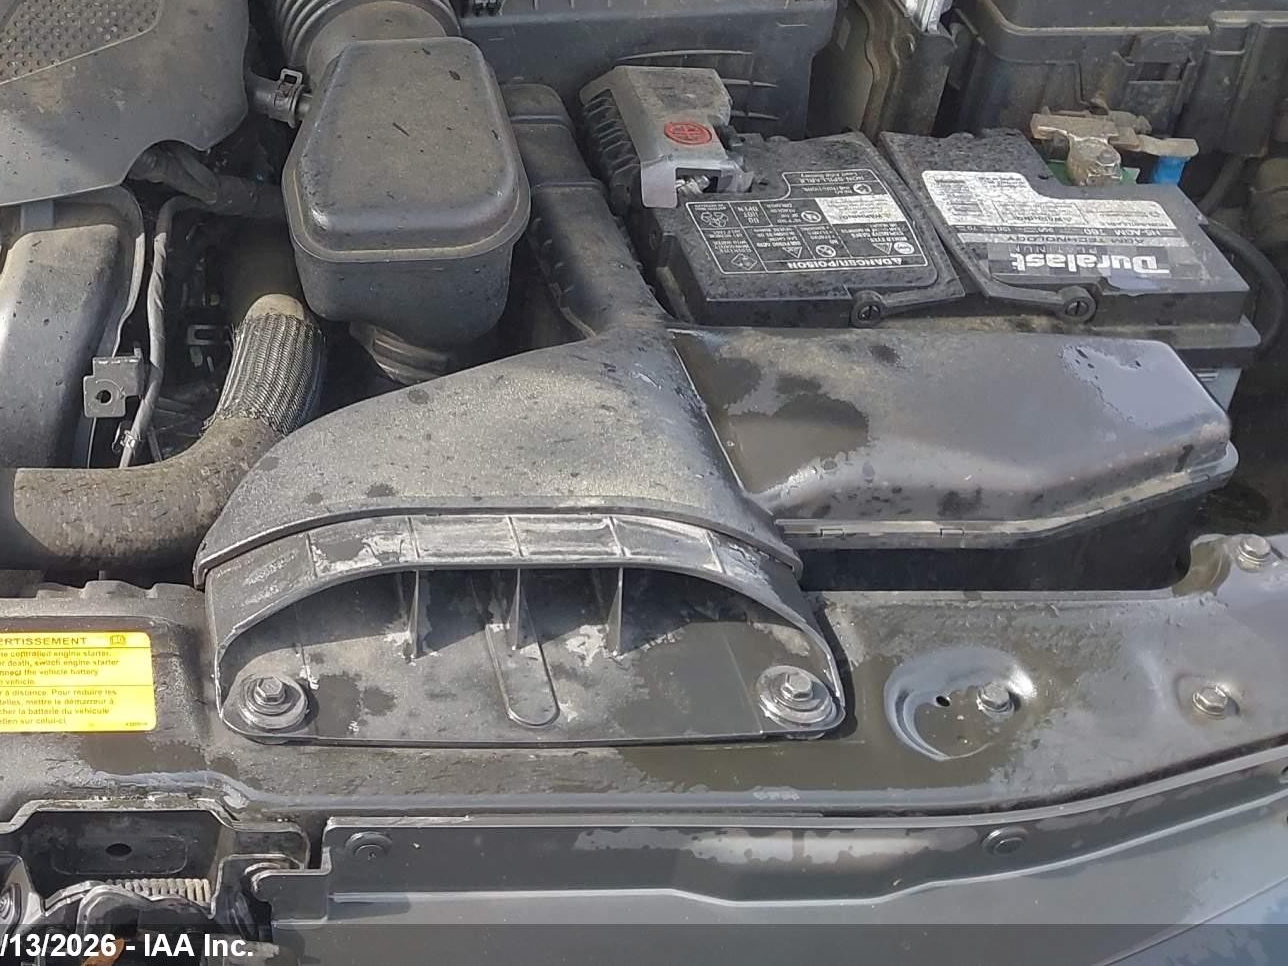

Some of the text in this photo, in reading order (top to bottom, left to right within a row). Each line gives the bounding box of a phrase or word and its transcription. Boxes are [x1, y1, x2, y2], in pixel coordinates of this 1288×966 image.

[1010, 253, 1170, 274] Duralast
[54, 650, 81, 658] engine
[63, 660, 91, 668] engine
[70, 668, 98, 676] battery
